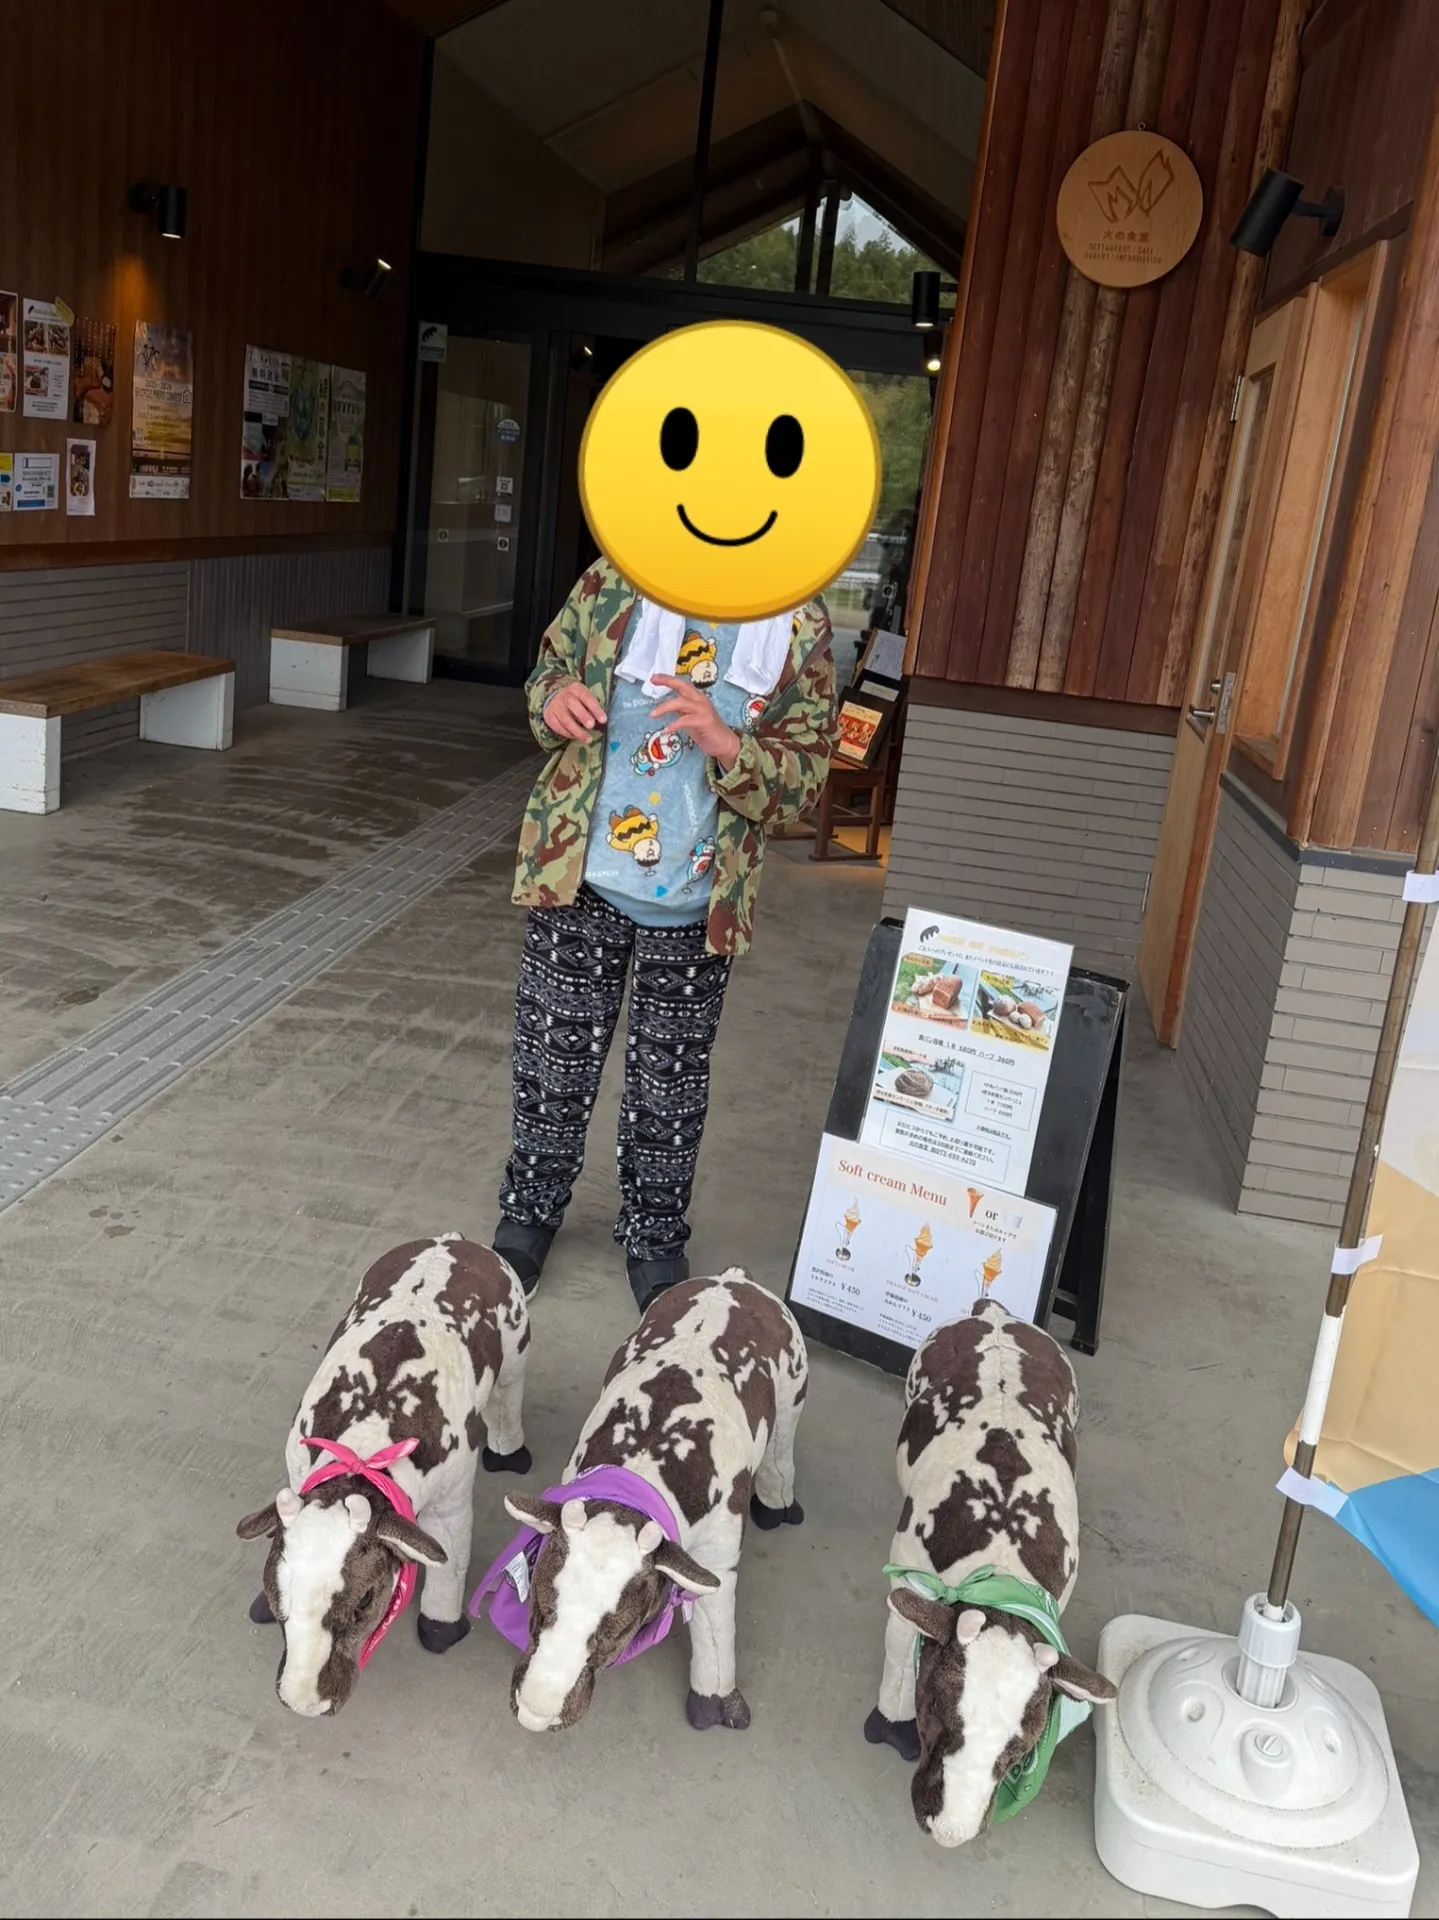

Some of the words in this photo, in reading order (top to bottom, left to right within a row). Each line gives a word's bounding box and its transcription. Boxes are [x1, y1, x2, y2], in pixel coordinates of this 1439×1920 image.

[838, 1159, 863, 1178] Soft
[866, 1169, 907, 1192] cream
[910, 1182, 948, 1207] Menu
[985, 1209, 999, 1220] or
